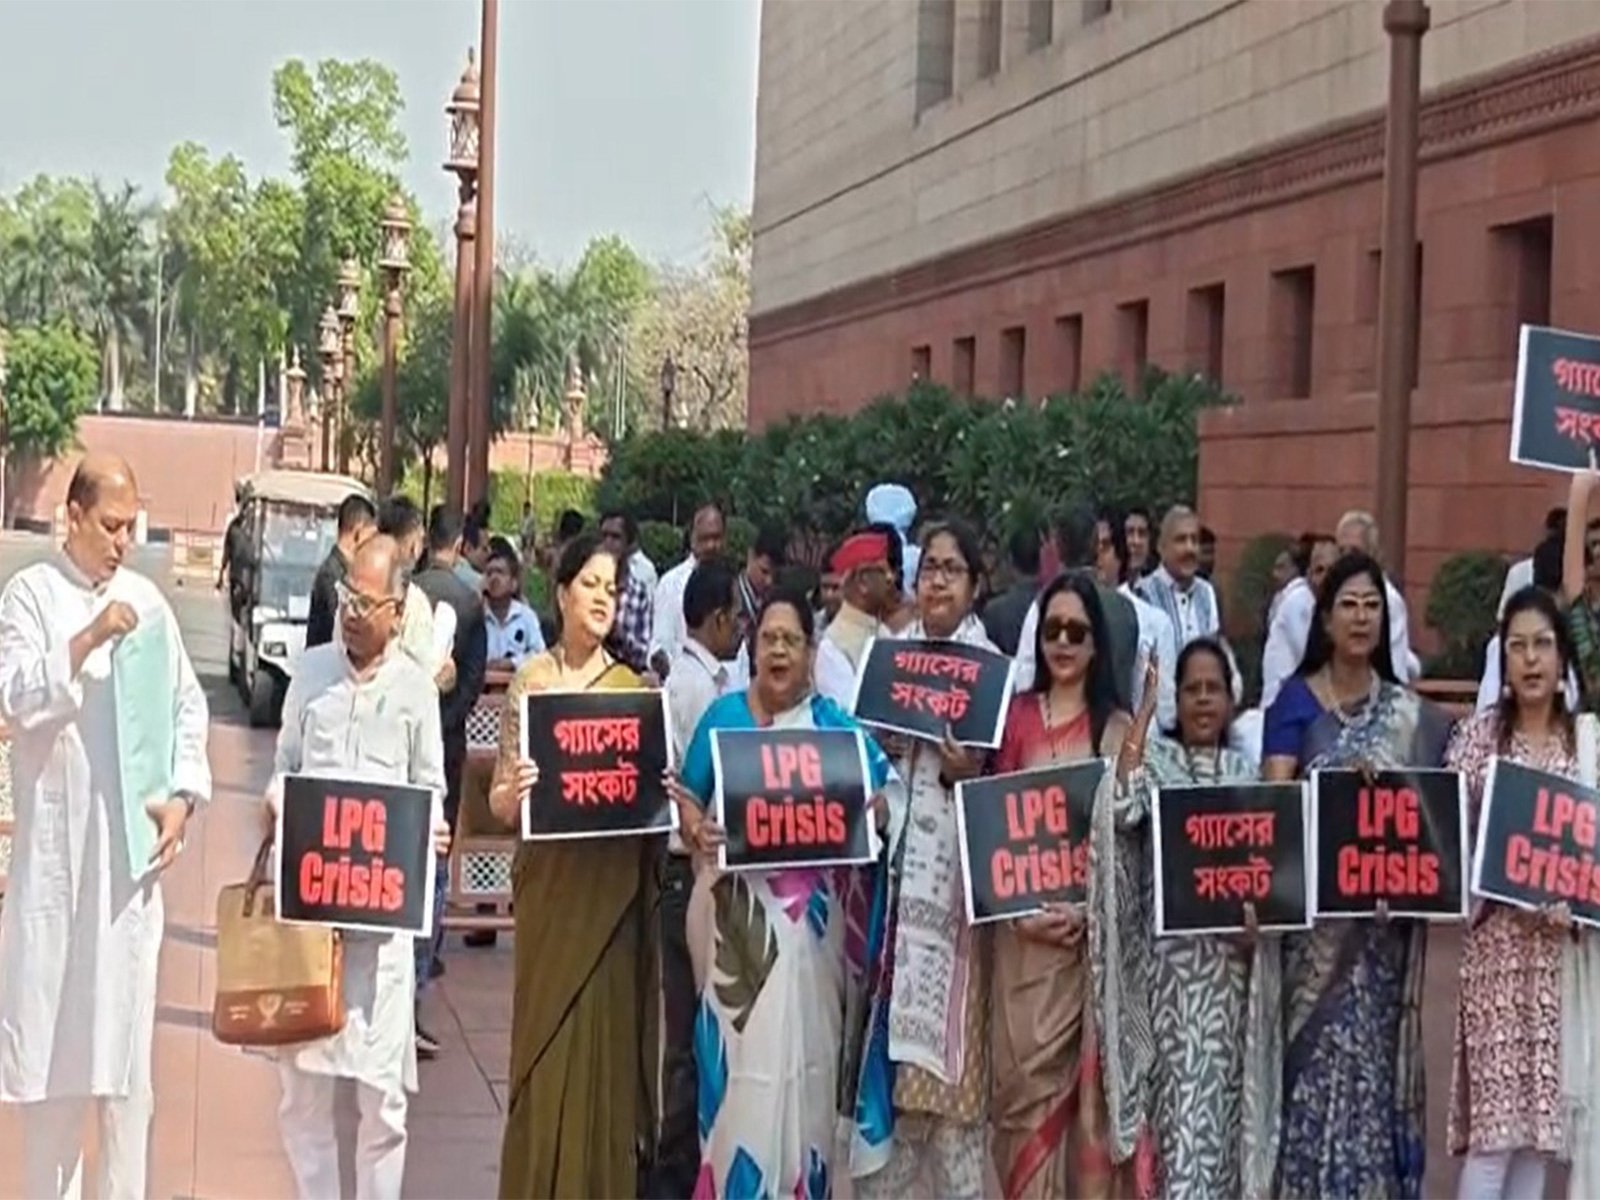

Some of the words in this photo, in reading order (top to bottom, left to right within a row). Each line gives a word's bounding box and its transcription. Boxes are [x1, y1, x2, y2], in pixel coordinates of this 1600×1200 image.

[1553, 357, 1600, 397] গ্যা
[1554, 405, 1600, 443] সং
[893, 650, 980, 684] গ্যাসের
[890, 680, 971, 722] সংকট
[553, 715, 641, 755] গ্যাসের
[561, 765, 640, 806] সংকট
[761, 744, 823, 790] LPG
[322, 797, 385, 852] LPG
[745, 797, 847, 849] Crisis
[1005, 785, 1068, 841] LPG
[1185, 811, 1275, 847] গ্যাসের
[1357, 788, 1420, 838] LPG
[1533, 788, 1597, 848] LPG
[299, 854, 405, 913] Crisis
[1194, 856, 1273, 900] সংকট
[1337, 844, 1440, 897] Crisis
